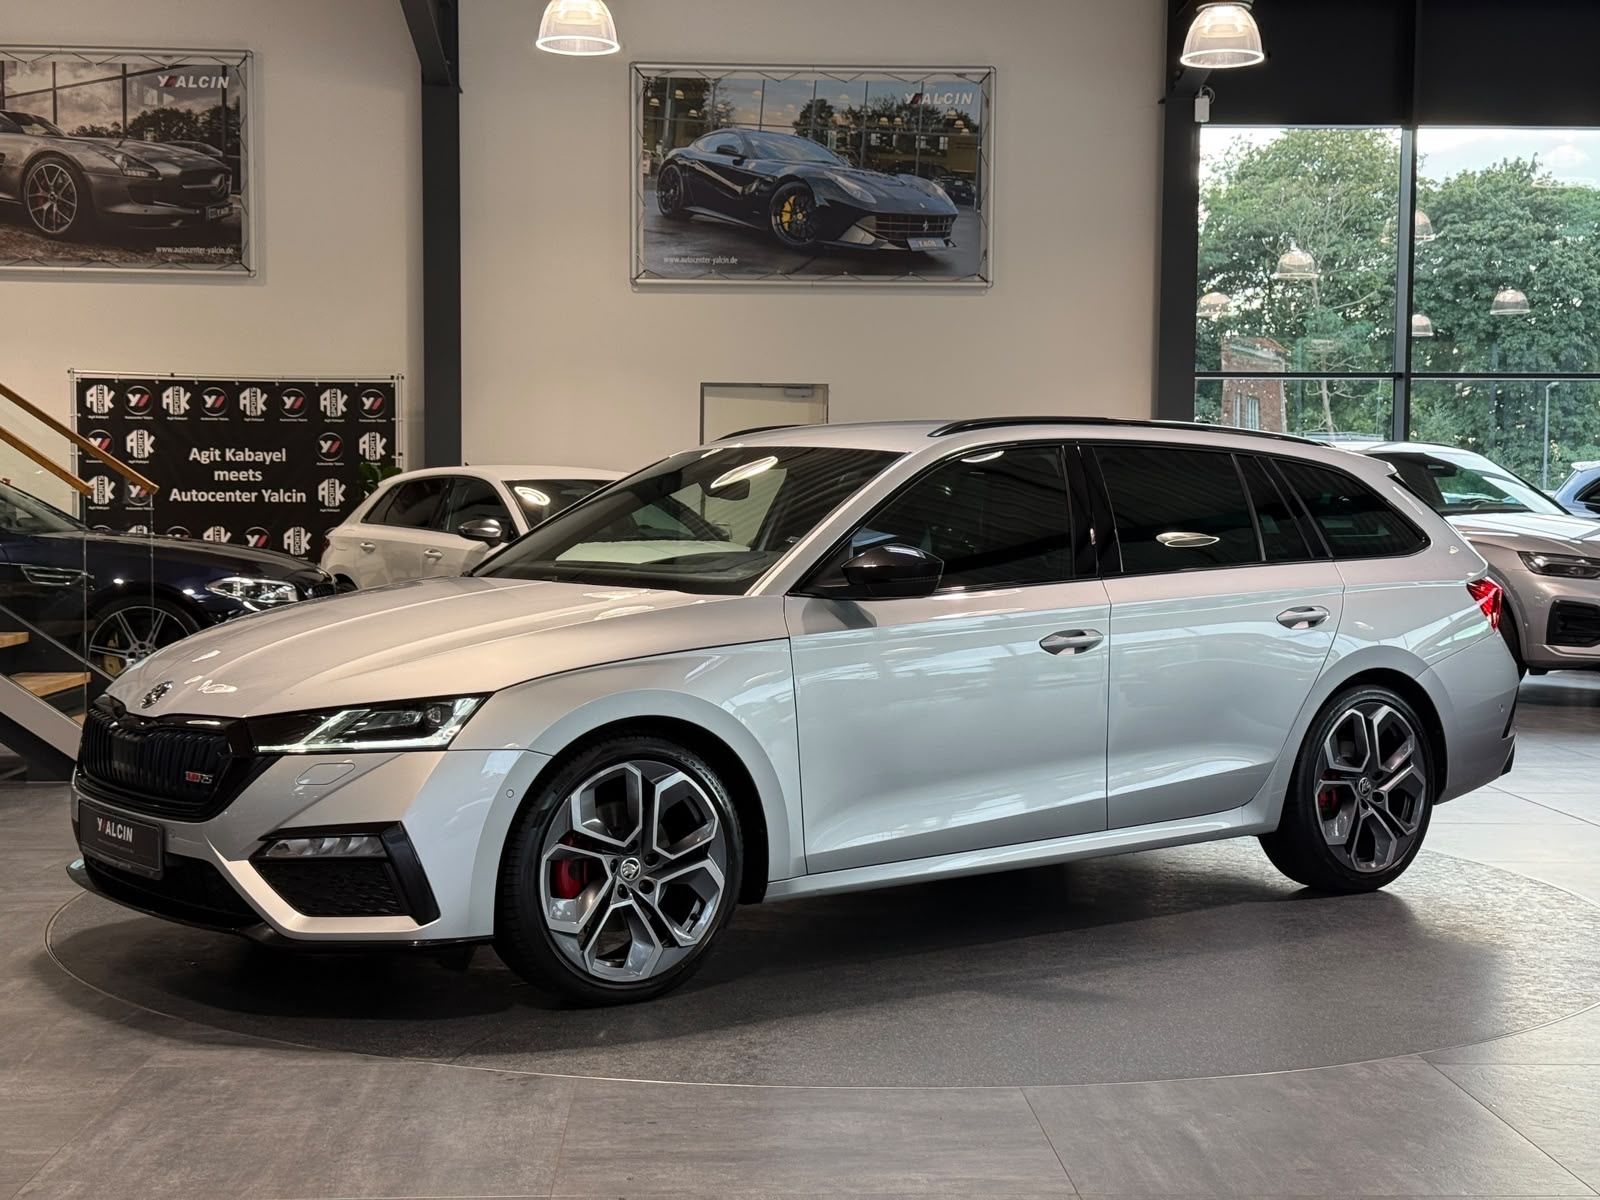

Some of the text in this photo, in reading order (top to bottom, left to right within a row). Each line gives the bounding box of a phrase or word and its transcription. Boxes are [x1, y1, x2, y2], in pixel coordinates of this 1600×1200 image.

[189, 447, 287, 465] Agit Kabayel
[213, 468, 263, 482] meets
[169, 488, 307, 503] Autocenter Yalcin
